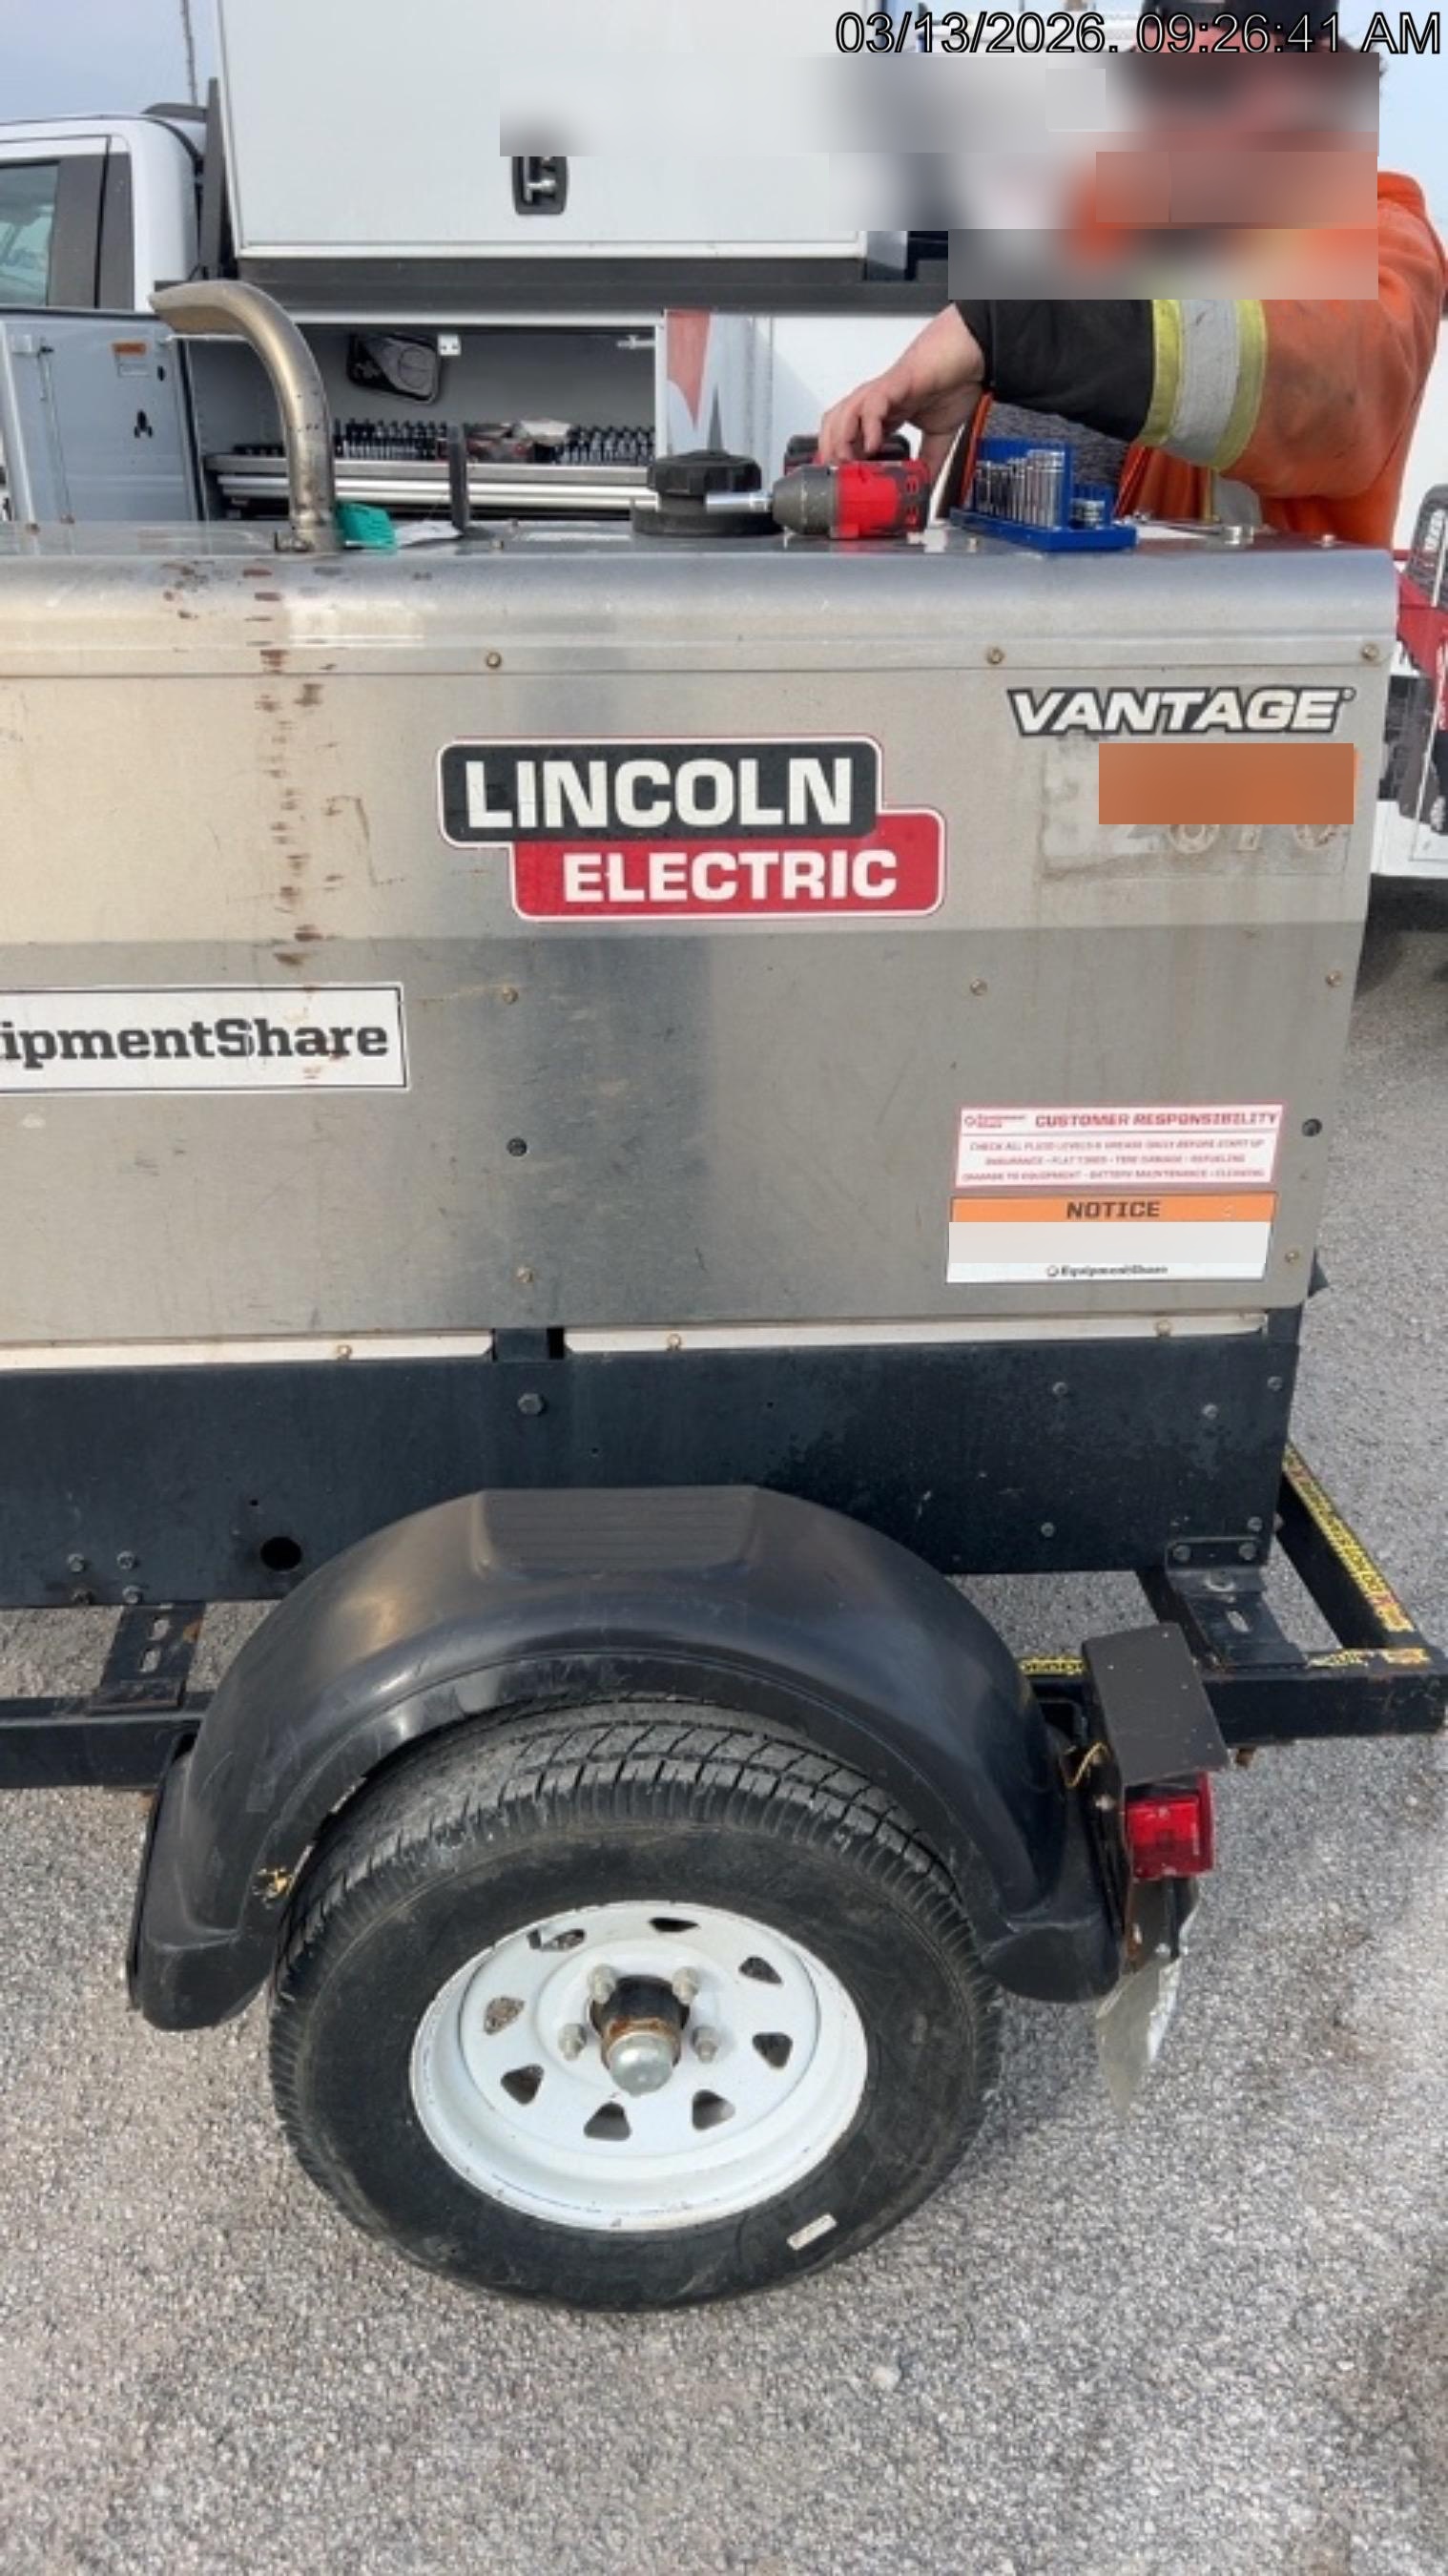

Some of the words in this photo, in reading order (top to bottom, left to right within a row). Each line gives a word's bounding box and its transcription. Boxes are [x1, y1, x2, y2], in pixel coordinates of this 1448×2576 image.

[465, 758, 853, 828] LINCOLN
[563, 849, 898, 904] ELECTRIC
[0, 1018, 388, 1069] ipmentShare
[1035, 1112, 1129, 1128] CUSTOMER
[1132, 1111, 1276, 1127] RESPONSIBILITY
[1066, 1200, 1161, 1219] NOTICE
